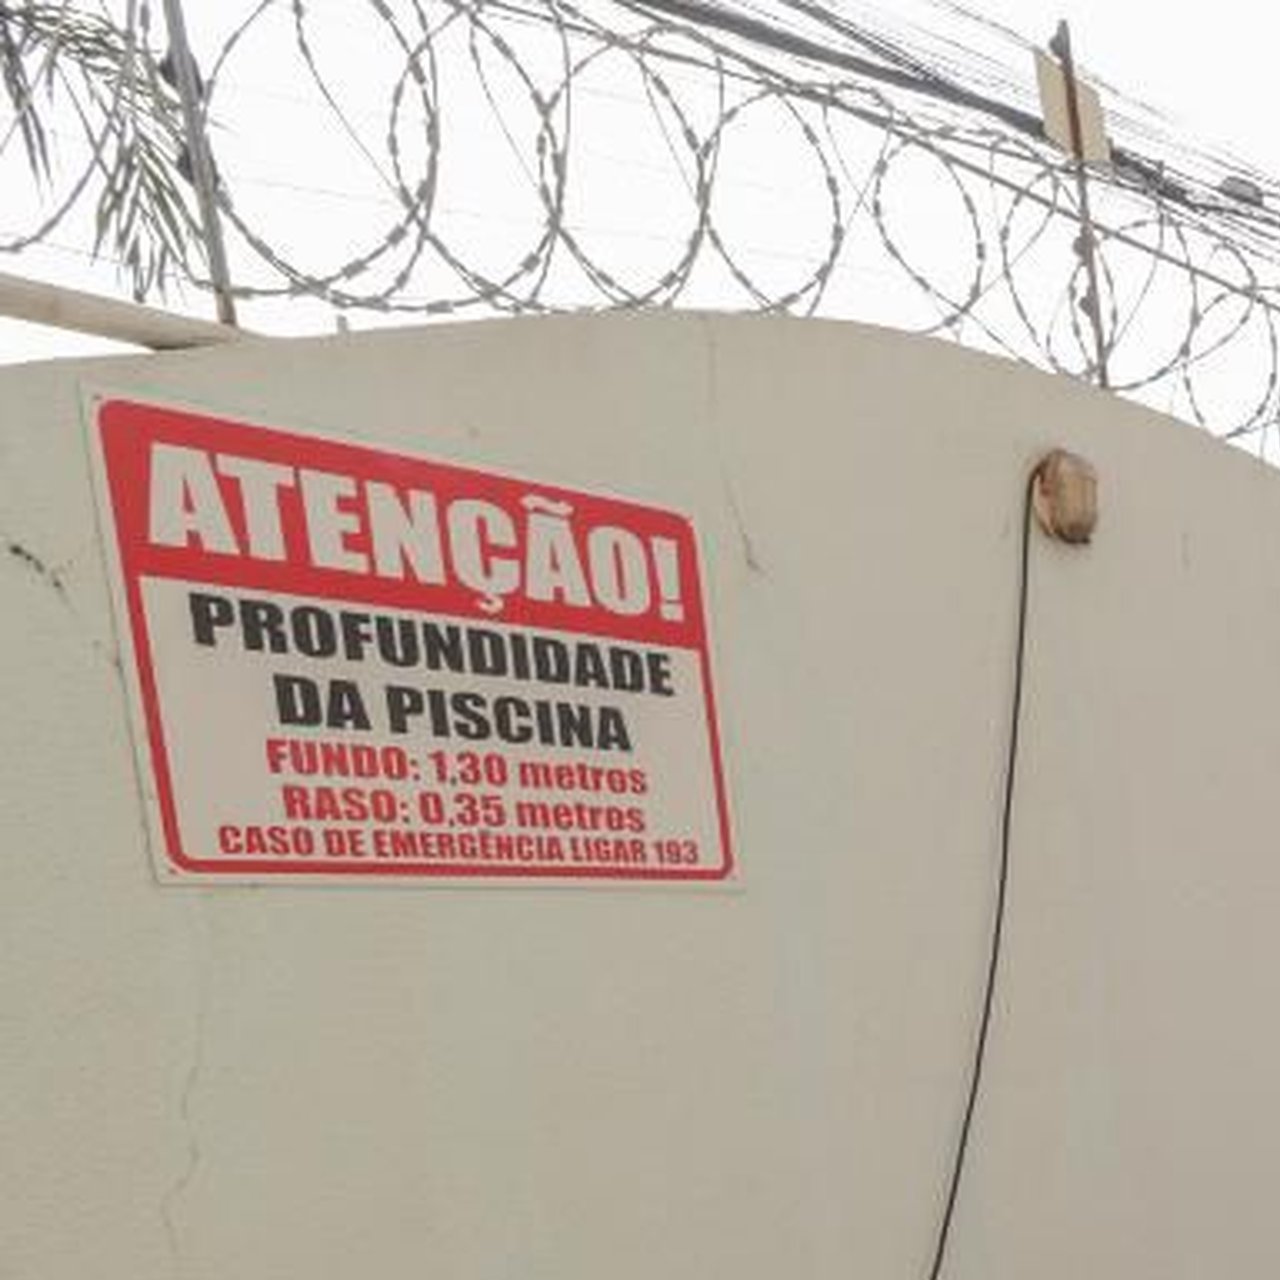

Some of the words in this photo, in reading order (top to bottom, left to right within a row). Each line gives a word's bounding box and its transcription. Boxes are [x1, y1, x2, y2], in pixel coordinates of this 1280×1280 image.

[148, 443, 685, 624] ATENÇÃO!
[188, 594, 676, 697] PROFUNDIDADE
[273, 674, 371, 732] DA
[384, 684, 632, 752] PISCINA
[265, 738, 420, 783] FUNDO:
[519, 757, 648, 795] metros
[282, 785, 411, 824] RASO:
[515, 797, 646, 832] metros
[218, 826, 318, 857] CASO
[324, 829, 369, 859] DE
[374, 829, 566, 863] EMERGÊNCIA
[571, 841, 648, 865] LIGAR
[656, 840, 700, 866] 193
